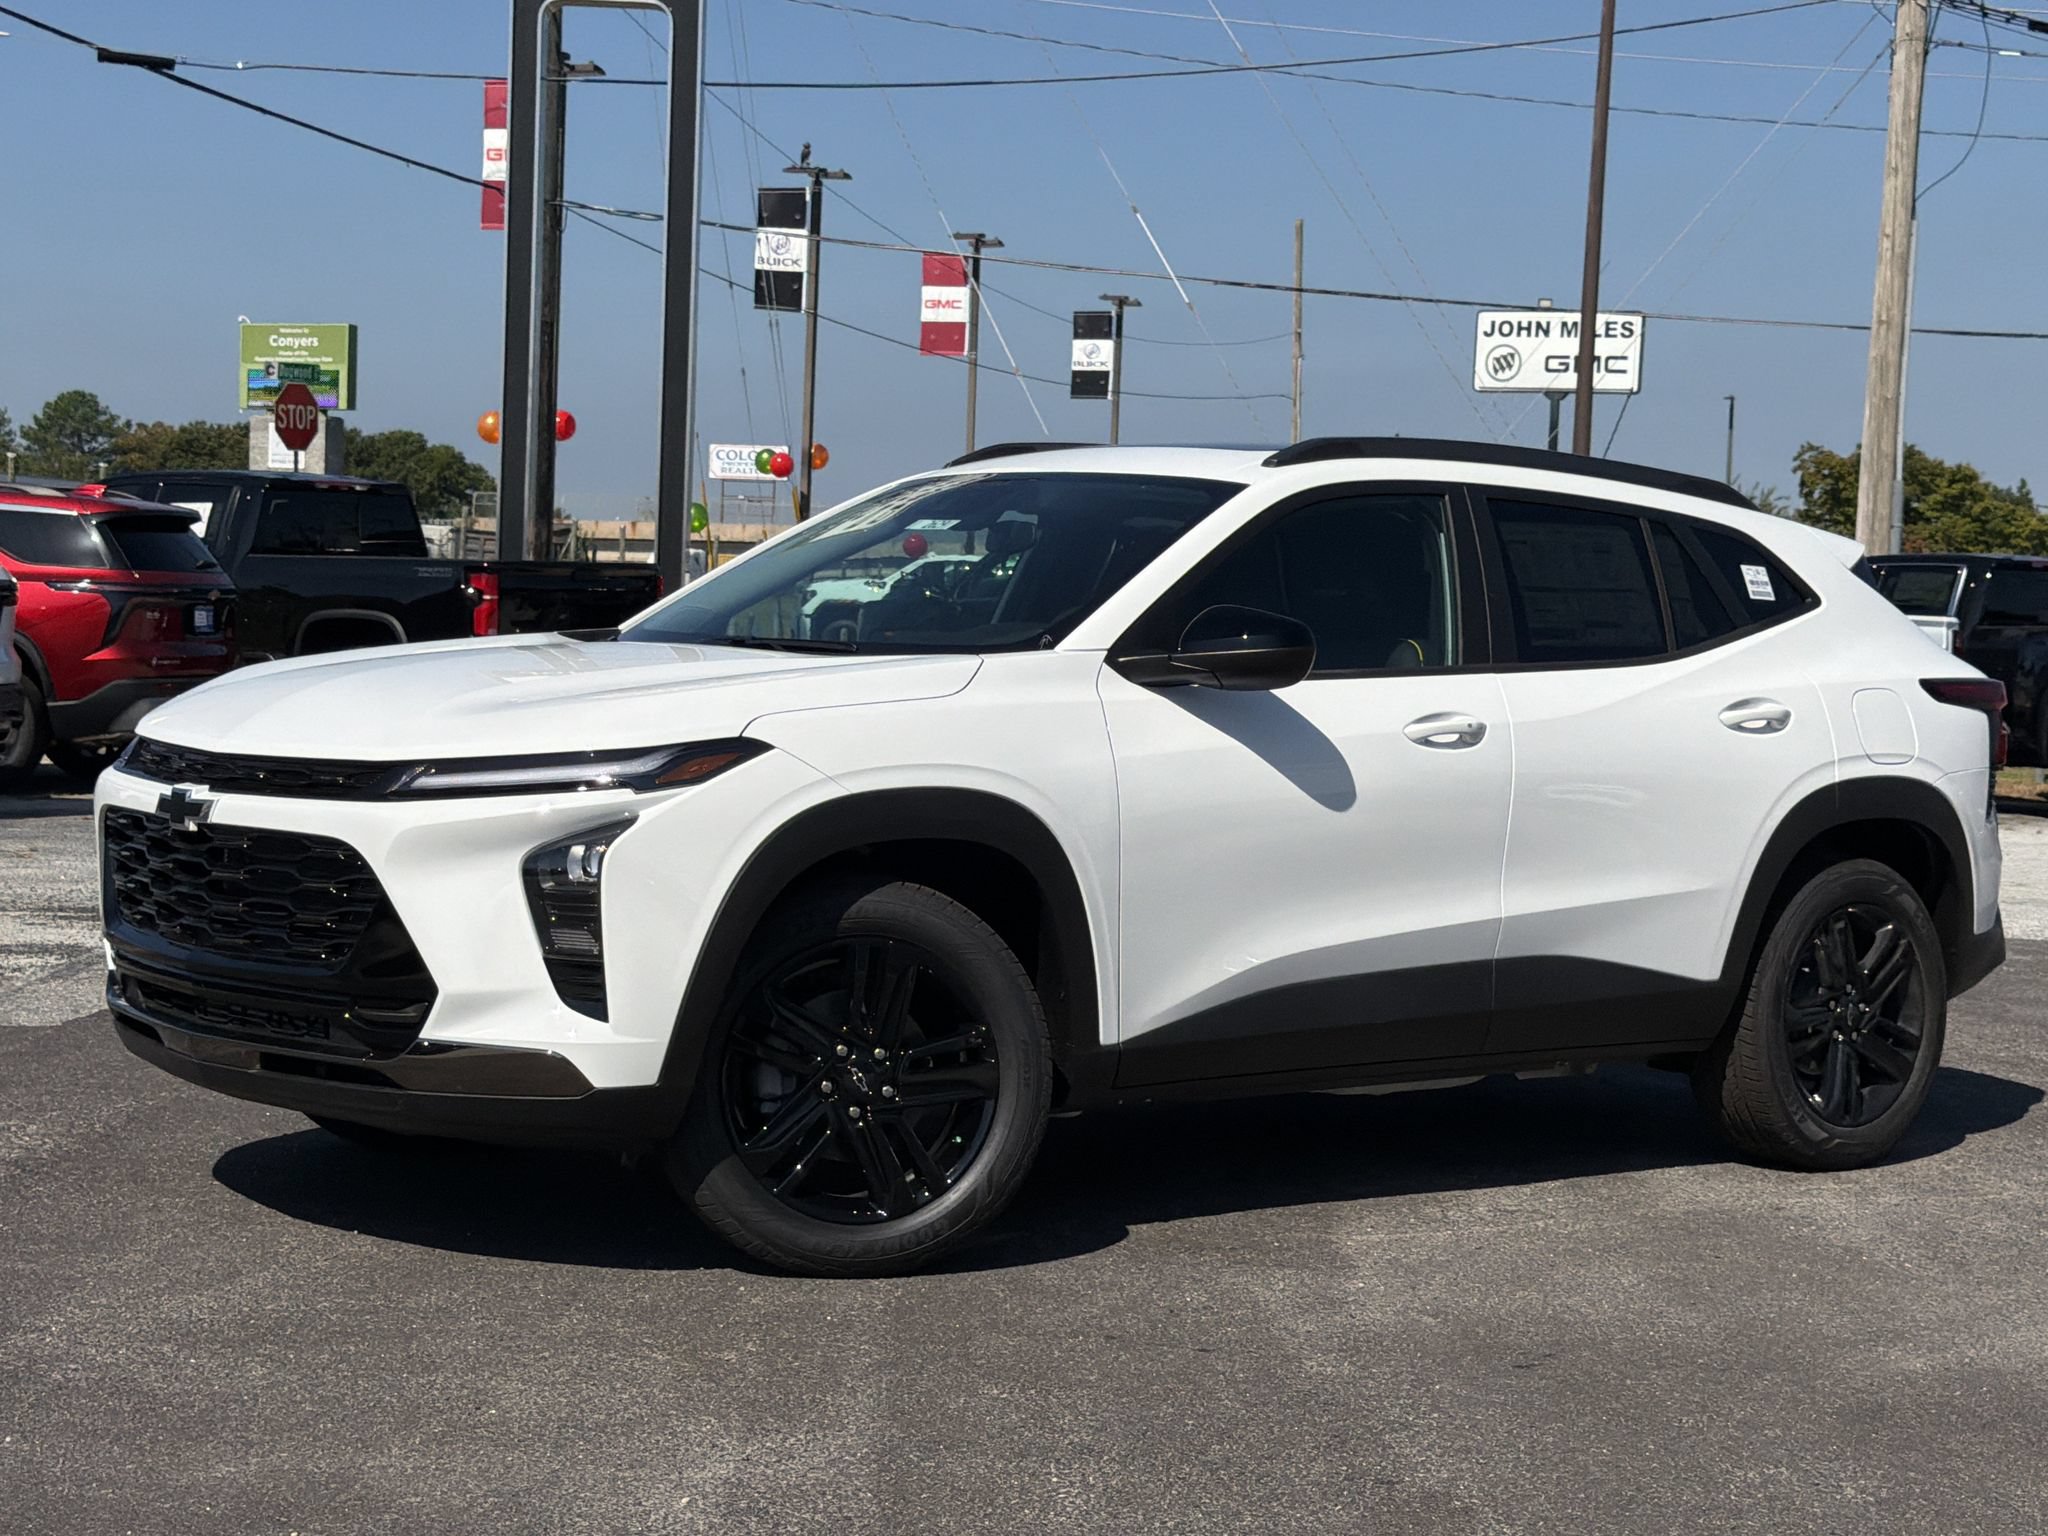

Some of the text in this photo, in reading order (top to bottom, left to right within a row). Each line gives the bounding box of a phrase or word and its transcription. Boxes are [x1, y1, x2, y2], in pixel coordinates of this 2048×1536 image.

[757, 256, 801, 267] BUICK
[924, 299, 962, 309] GMC
[1483, 320, 1634, 338] JOHN MES
[269, 334, 319, 349] Conyers
[1073, 360, 1109, 368] BUICK
[277, 403, 316, 430] STOP
[716, 449, 758, 461] COLO
[720, 466, 758, 474] REALT
